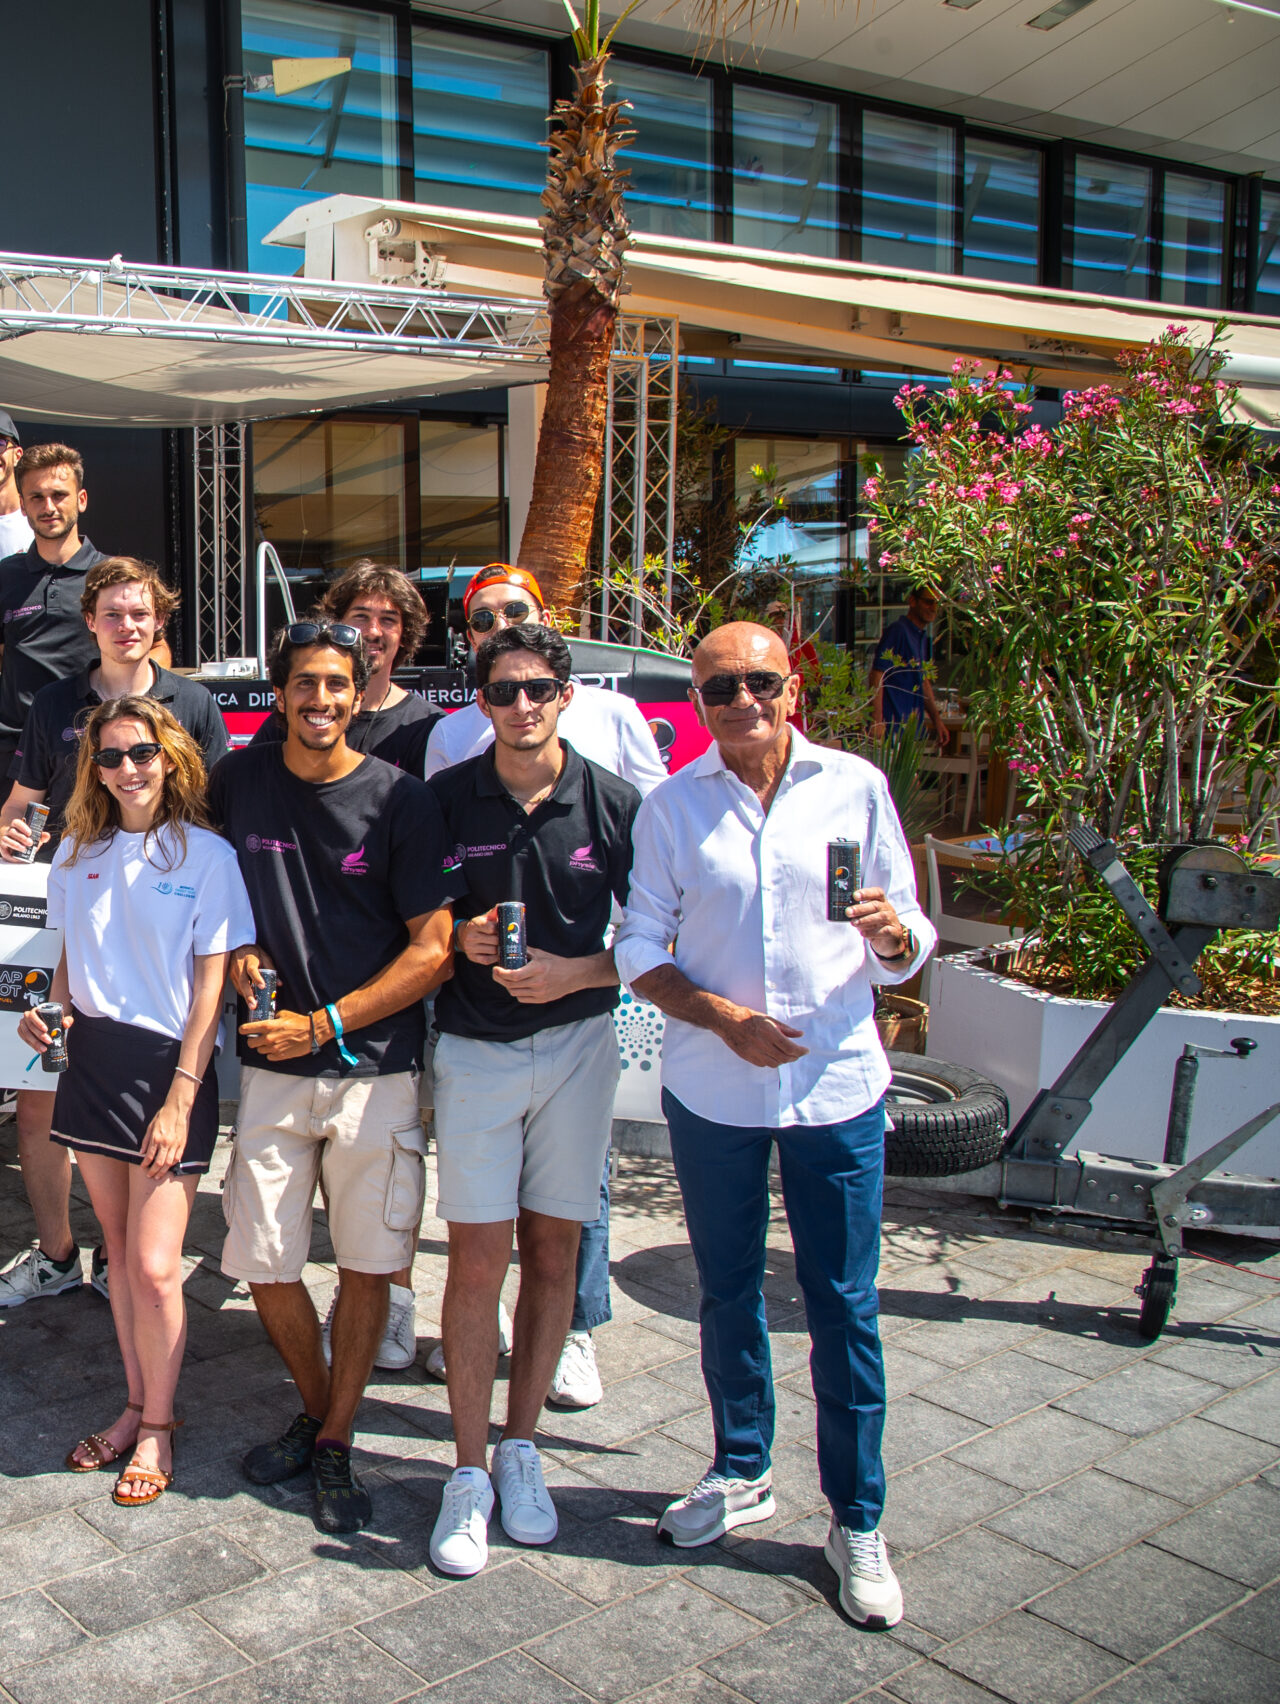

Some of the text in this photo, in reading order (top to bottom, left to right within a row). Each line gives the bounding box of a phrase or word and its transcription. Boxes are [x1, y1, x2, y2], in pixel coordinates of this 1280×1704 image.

[212, 692, 277, 707] ICA DIP
[261, 838, 297, 851] POLITECNICO
[467, 843, 507, 852] POLITECNICO
[12, 905, 48, 916] POLITECNIC
